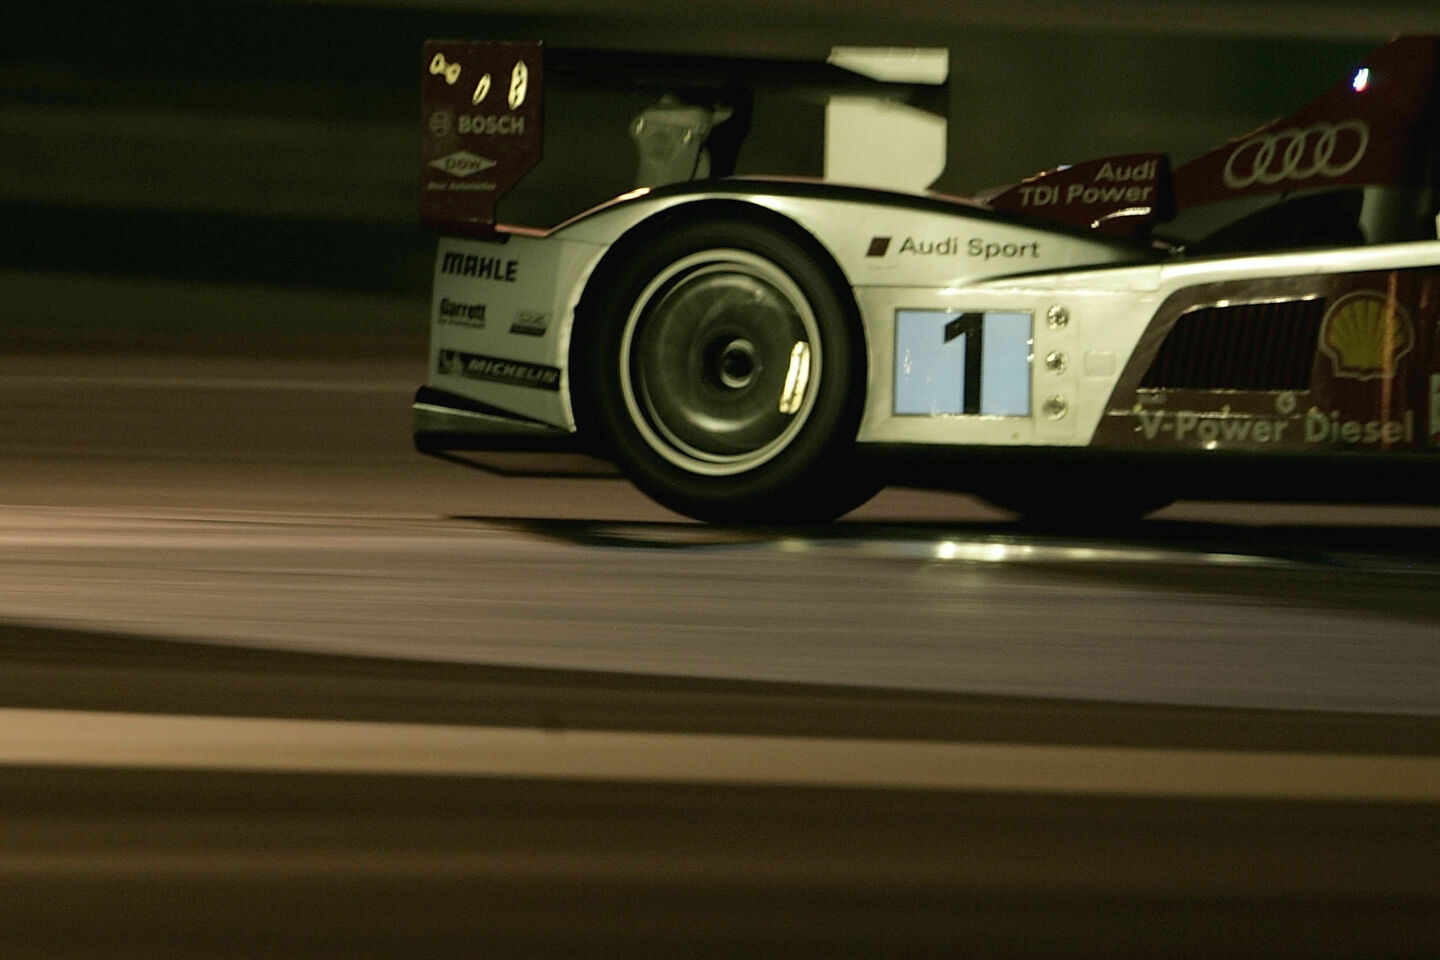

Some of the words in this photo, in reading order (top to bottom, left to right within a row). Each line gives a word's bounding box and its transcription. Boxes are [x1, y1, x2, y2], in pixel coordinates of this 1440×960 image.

[458, 115, 525, 135] BOSCH
[1095, 160, 1158, 182] Audi
[1018, 185, 1060, 207] TDI
[1065, 183, 1153, 205] Power
[899, 236, 959, 256] Audi
[968, 238, 1040, 260] Sport
[442, 252, 519, 282] MAHLE
[467, 359, 558, 384] MICHELIN
[944, 313, 984, 414] 1
[1139, 409, 1289, 442] V-Power
[1305, 408, 1414, 444] Diesel
